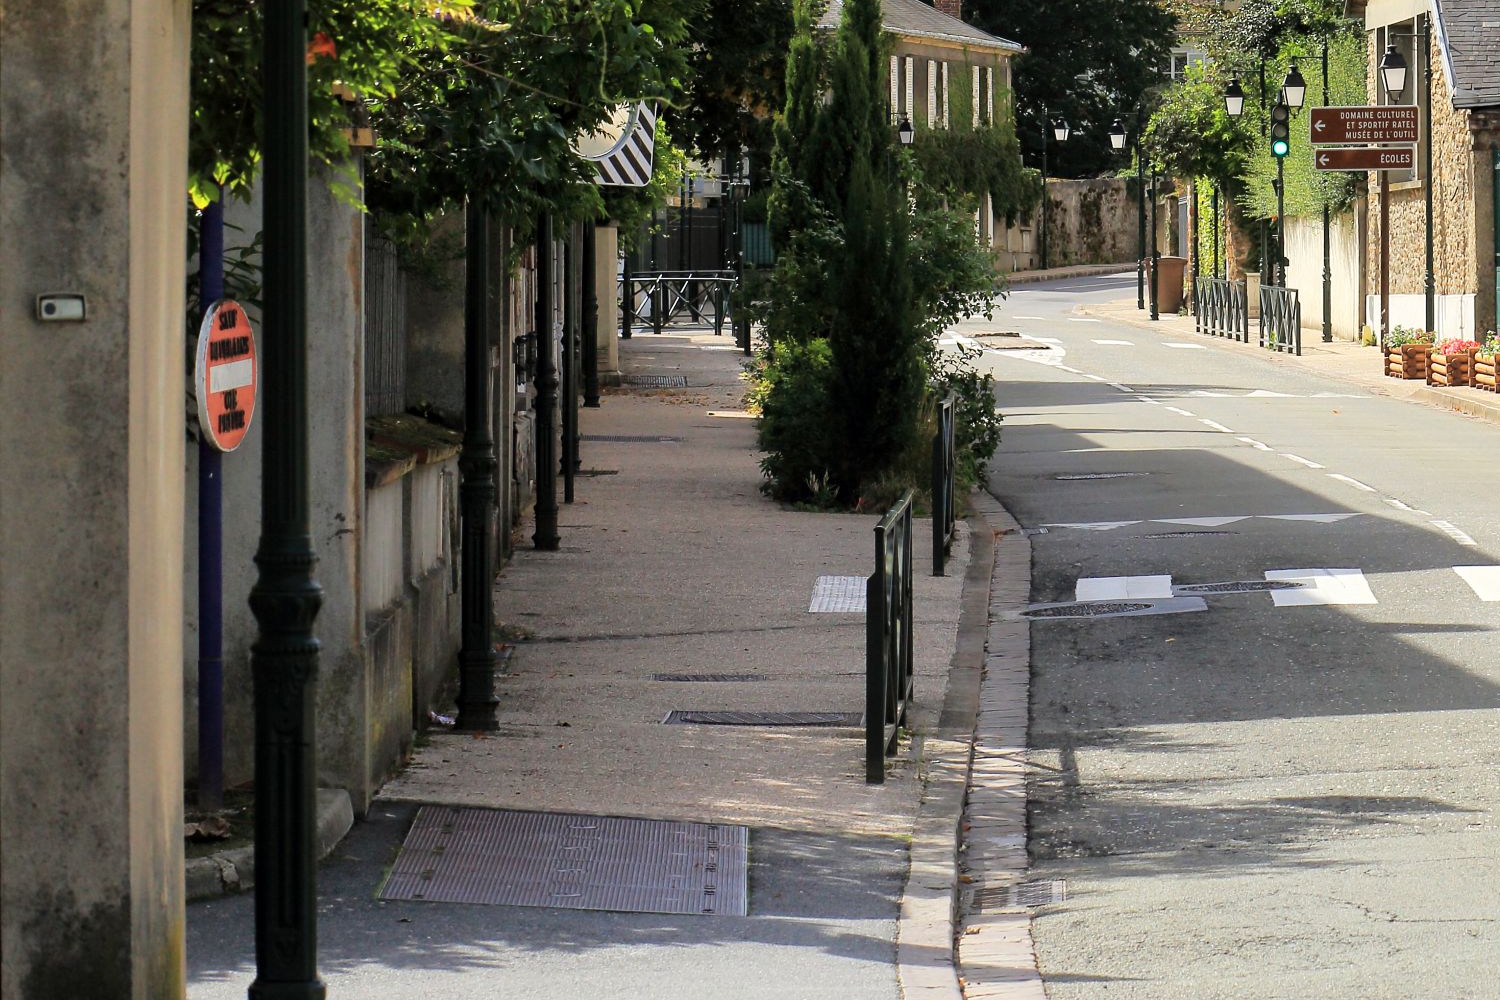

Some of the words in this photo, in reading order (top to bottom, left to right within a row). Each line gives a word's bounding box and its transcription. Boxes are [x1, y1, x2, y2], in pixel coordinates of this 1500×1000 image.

[1340, 111, 1374, 119] DOMAINE
[1358, 121, 1390, 129] SPORTIF
[1345, 130, 1371, 139] MUSÉE
[1373, 131, 1384, 139] DE
[1386, 130, 1415, 138] L'OUTIL
[1380, 153, 1411, 163] ÉCOLES
